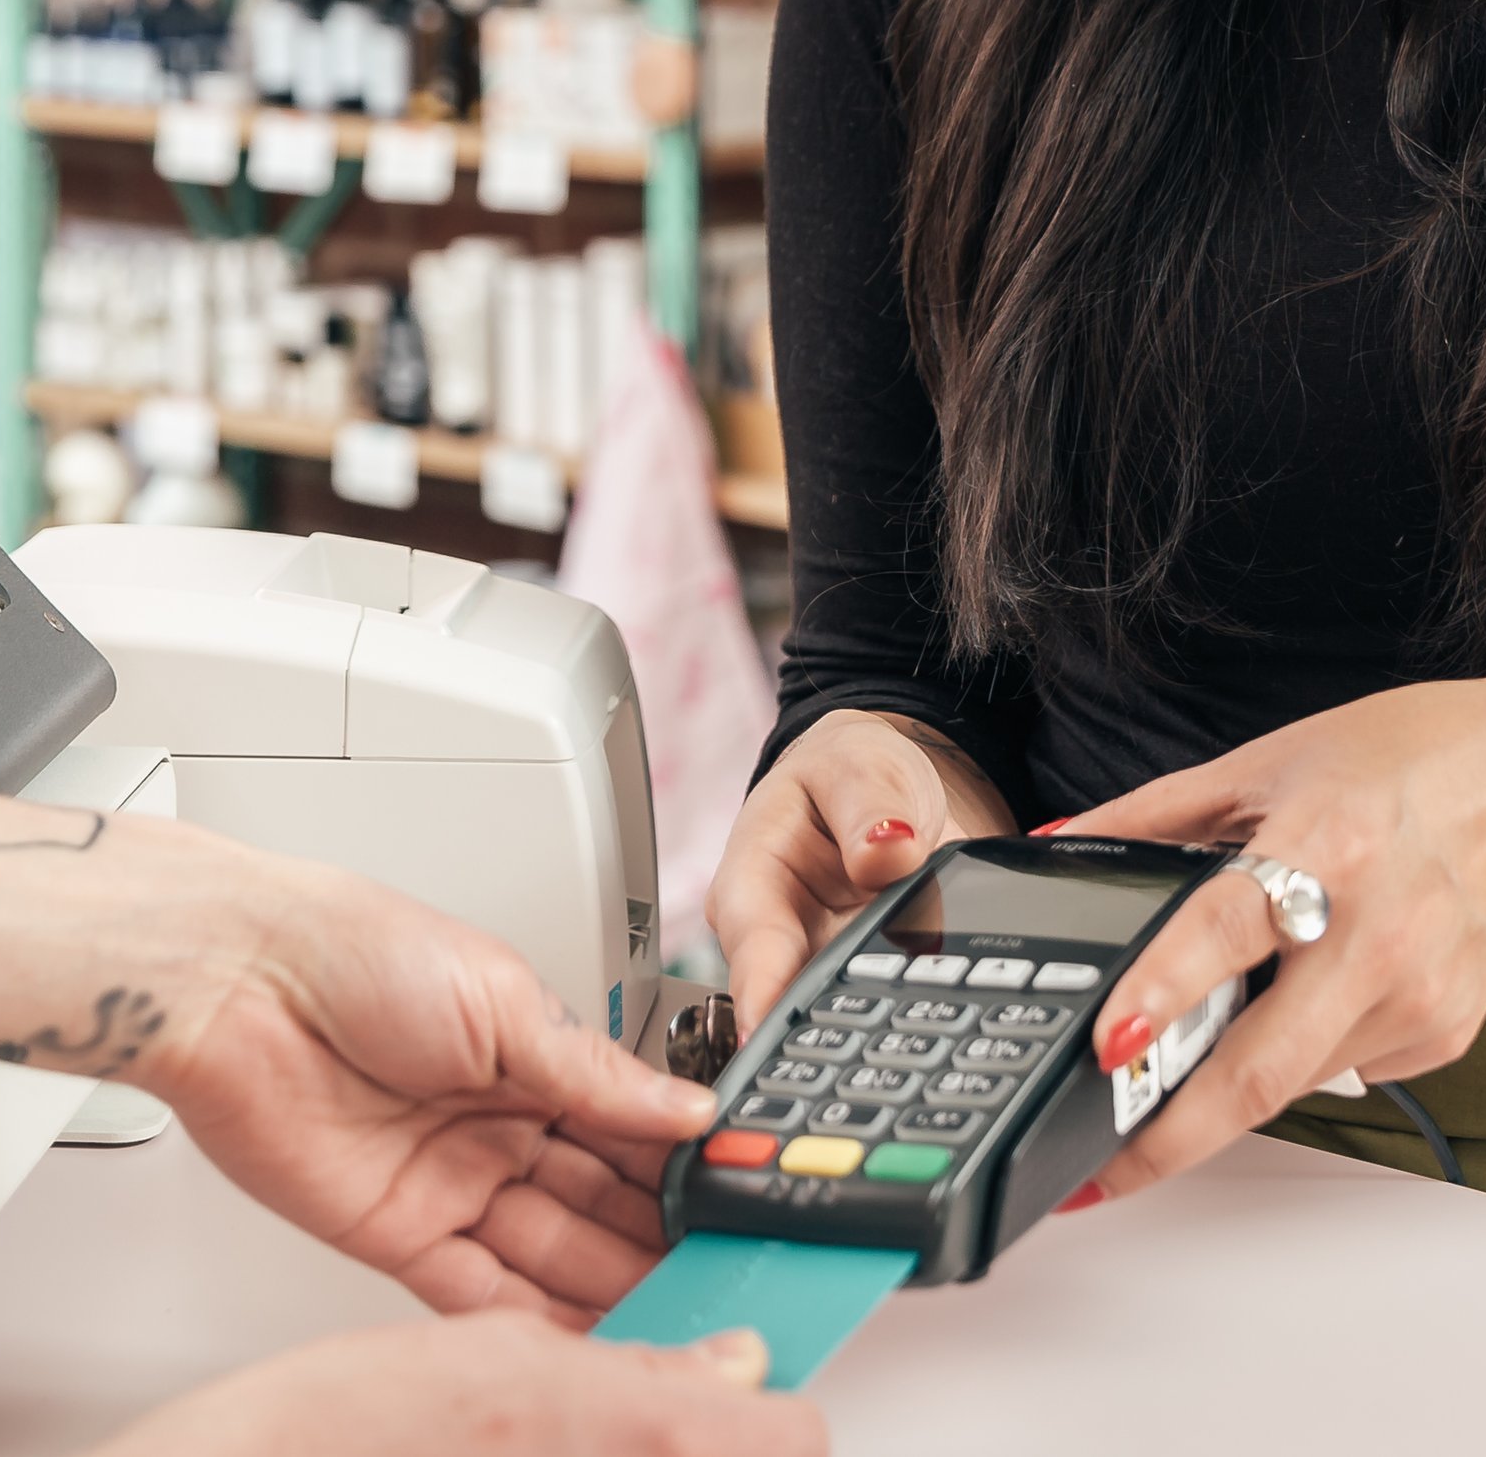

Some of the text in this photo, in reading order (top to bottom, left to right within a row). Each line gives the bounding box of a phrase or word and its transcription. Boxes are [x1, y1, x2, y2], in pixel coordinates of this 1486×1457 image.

[1051, 841, 1127, 854] ingenico
[906, 1001, 932, 1018] 2
[998, 1004, 1025, 1023] 3
[796, 1028, 820, 1045] 4
[879, 1033, 905, 1052] 5
[770, 1060, 793, 1079] 7
